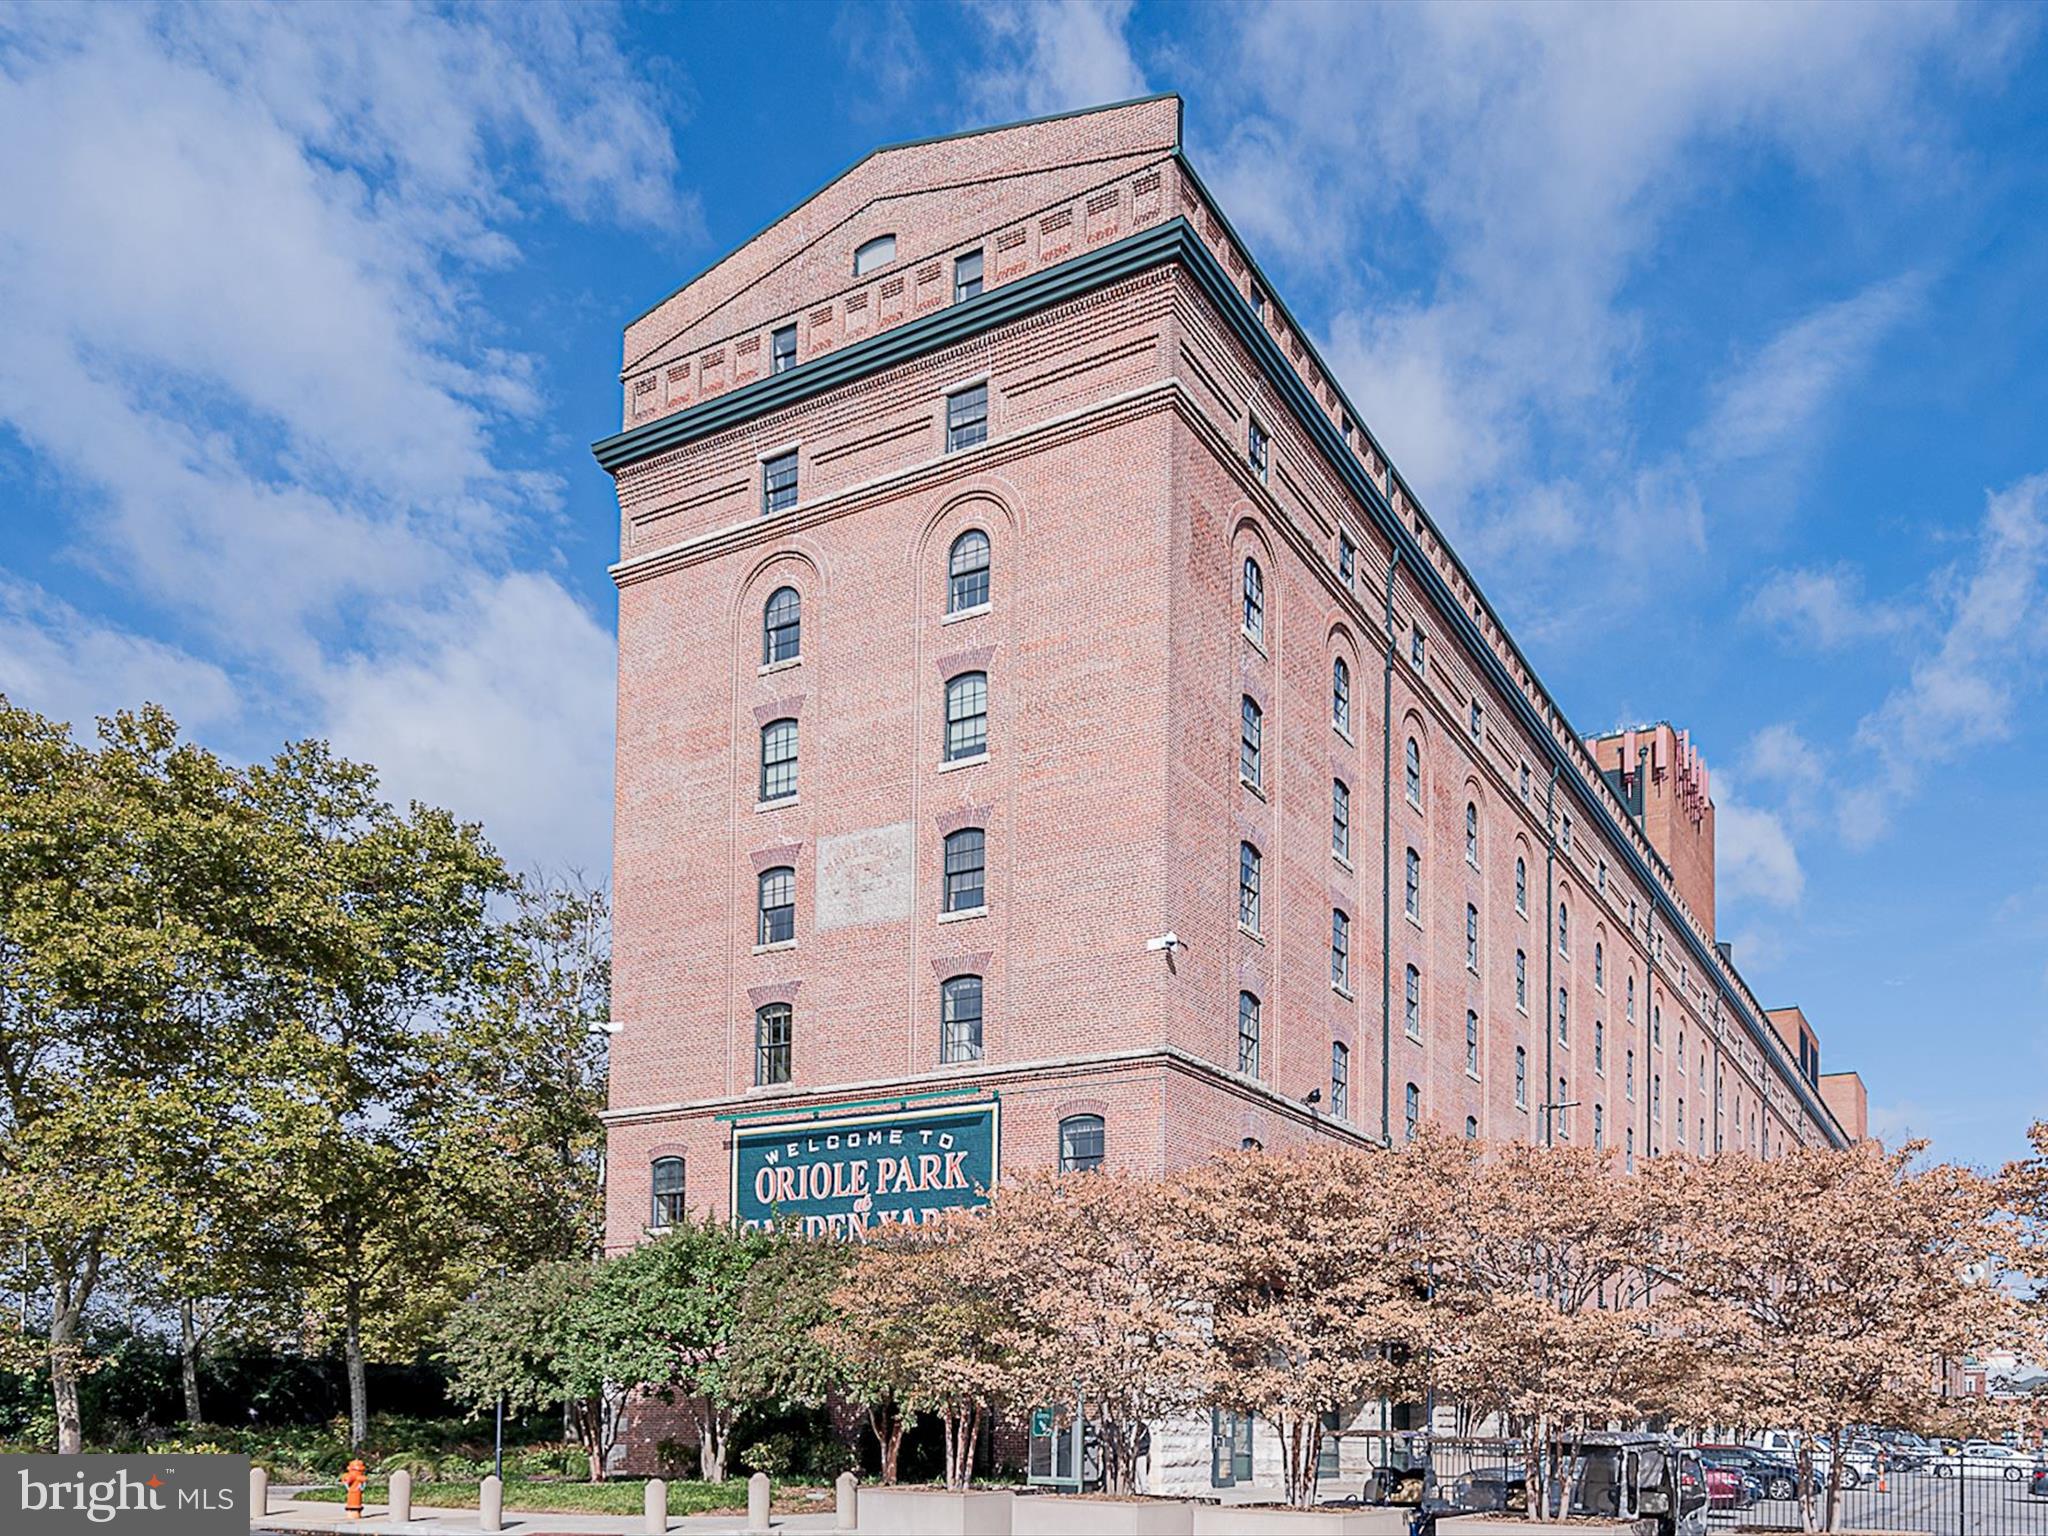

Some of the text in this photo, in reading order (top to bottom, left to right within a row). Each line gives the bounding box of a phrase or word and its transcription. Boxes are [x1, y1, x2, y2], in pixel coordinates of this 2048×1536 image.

[764, 1129, 955, 1166] WELCOME TO
[755, 1150, 969, 1204] ORIOLE PARK
[853, 1193, 873, 1213] at
